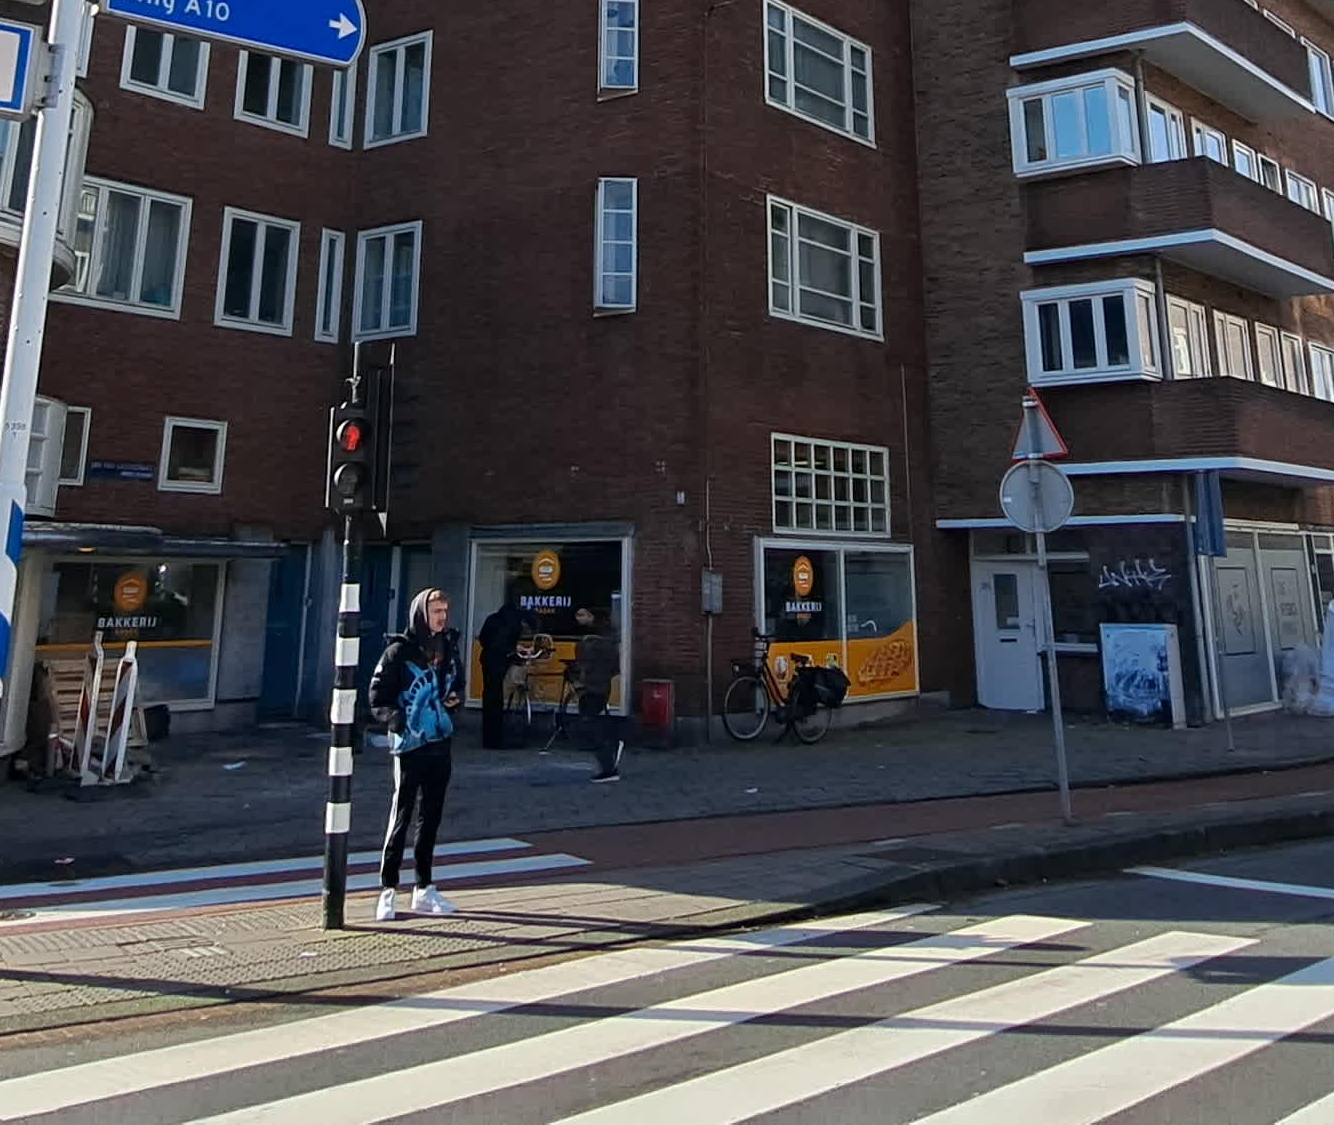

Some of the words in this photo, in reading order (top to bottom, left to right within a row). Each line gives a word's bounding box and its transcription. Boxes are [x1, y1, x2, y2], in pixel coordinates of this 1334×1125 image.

[520, 595, 572, 608] BAKKERIJ
[785, 602, 822, 612] BAKKERIJ
[97, 616, 157, 628] BAKKERIJ
